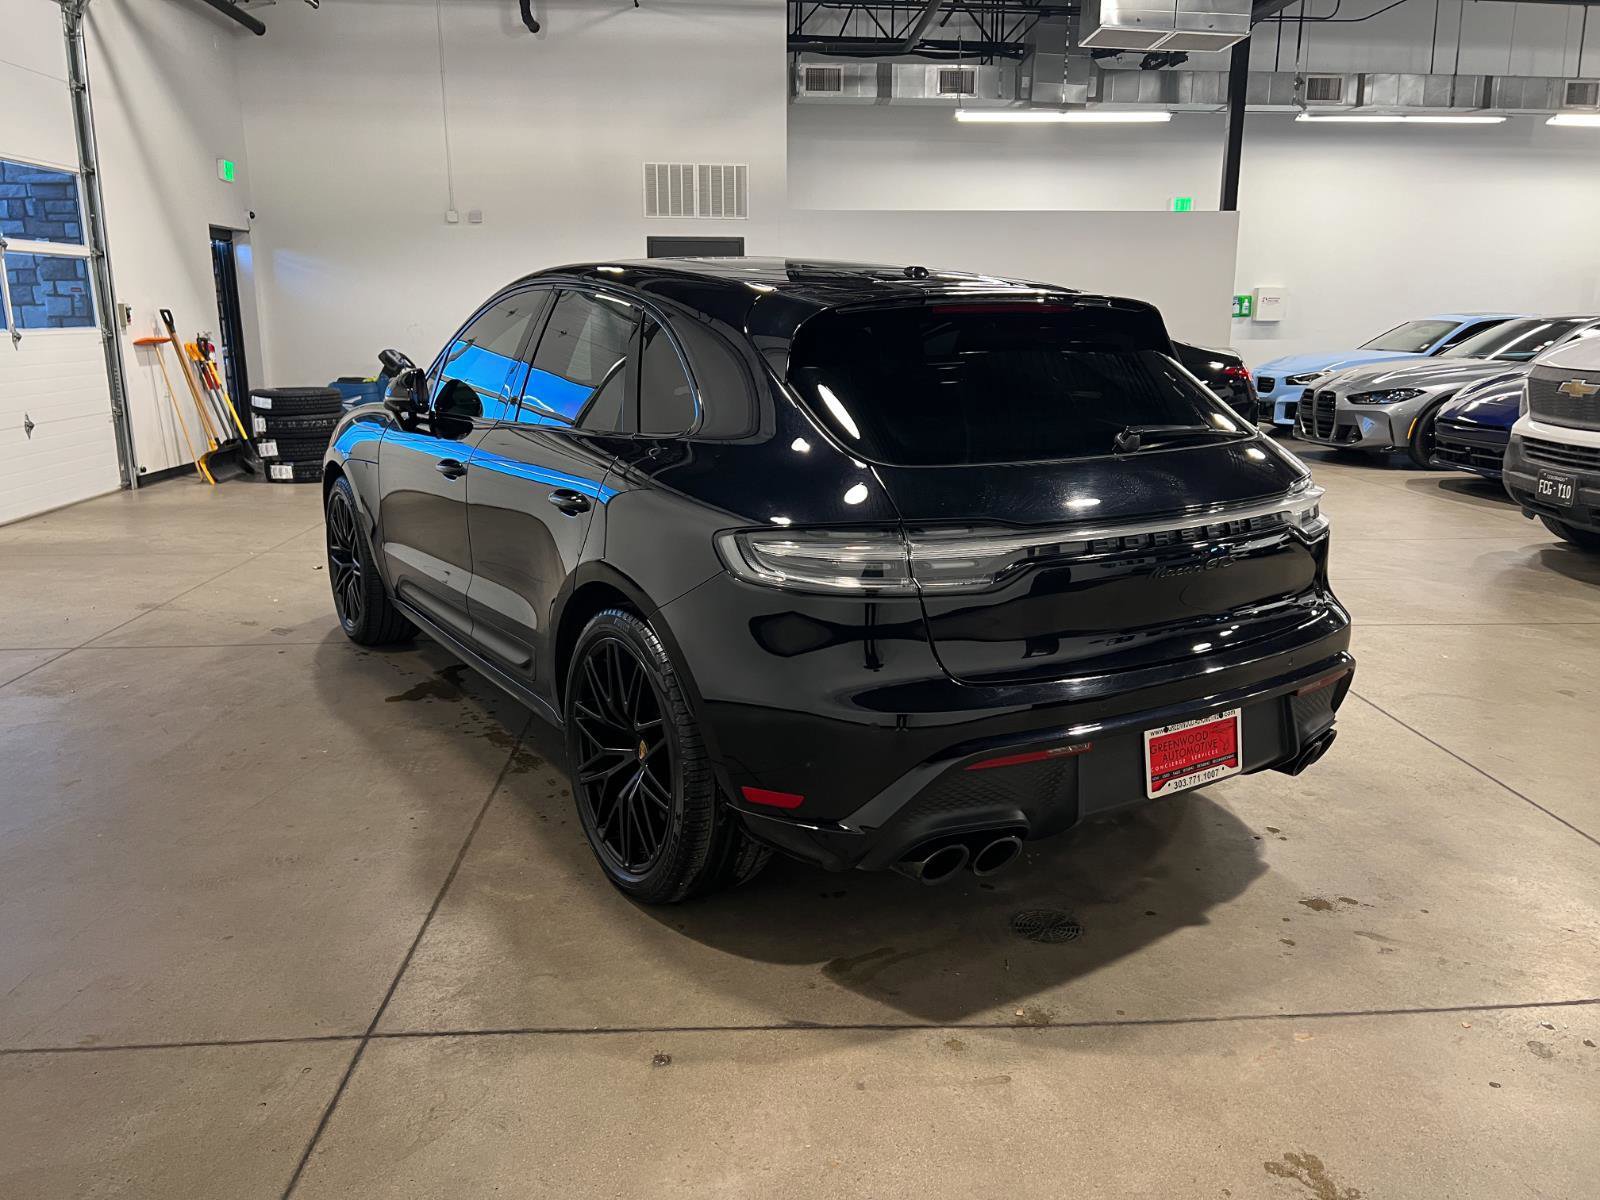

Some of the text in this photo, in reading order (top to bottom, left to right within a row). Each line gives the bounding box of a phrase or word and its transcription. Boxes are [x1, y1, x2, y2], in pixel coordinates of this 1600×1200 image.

[1092, 518, 1262, 553] PORSCHE
[1150, 731, 1209, 754] GREENWOOD
[1162, 739, 1217, 763] AUTOMOTIVE
[1191, 749, 1218, 761] SERVICES
[1174, 769, 1219, 789] 303.771.1007
